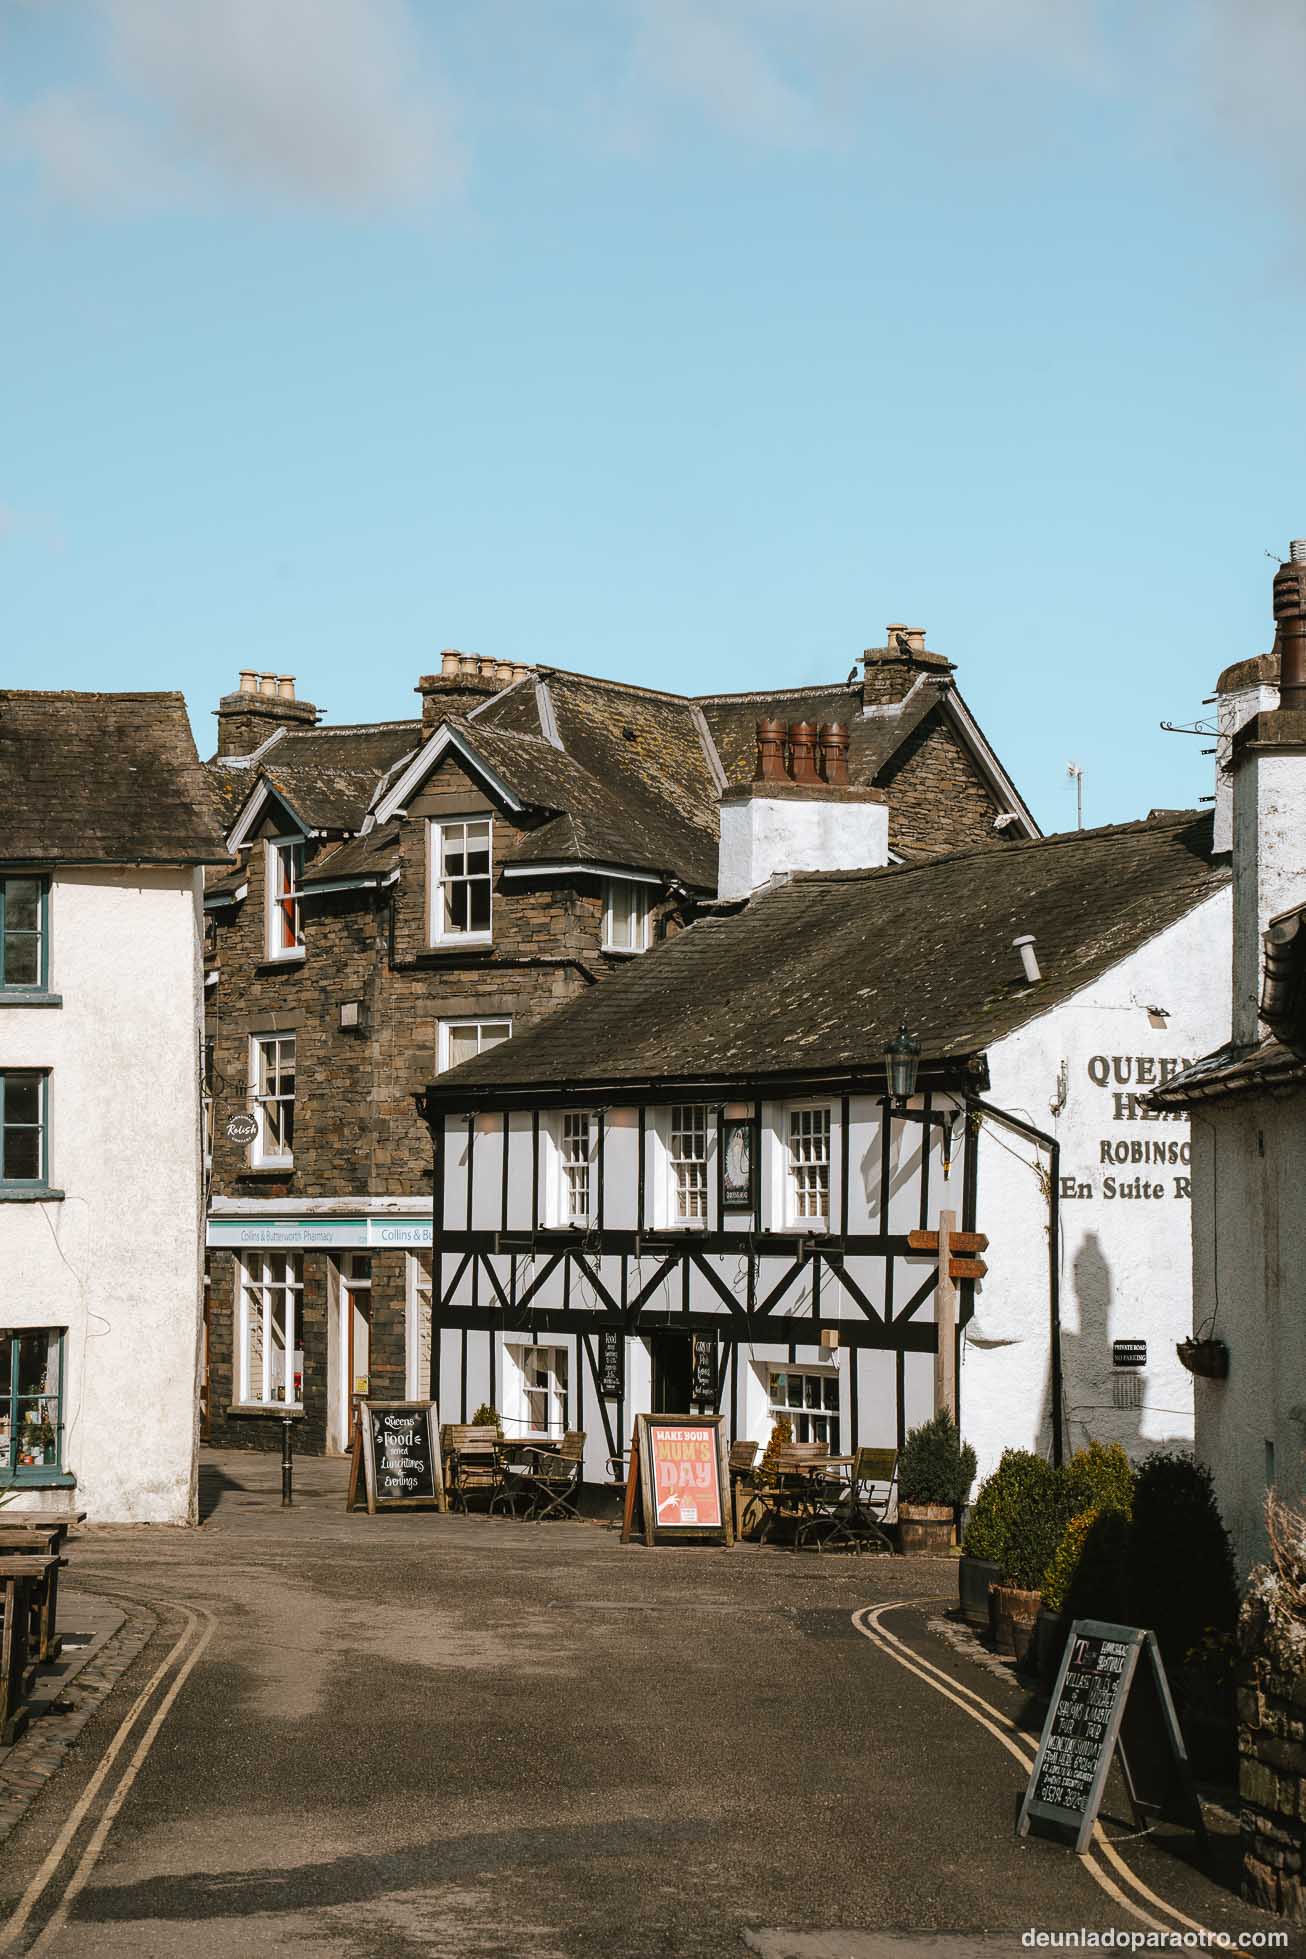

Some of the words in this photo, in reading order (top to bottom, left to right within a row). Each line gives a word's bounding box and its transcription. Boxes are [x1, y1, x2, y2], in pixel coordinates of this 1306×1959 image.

[1060, 1177, 1093, 1199] En
[1103, 1176, 1164, 1199] Suite
[382, 1229, 411, 1241] Collins
[414, 1229, 421, 1241] &
[384, 1415, 415, 1430] Queens
[384, 1430, 413, 1446] Food
[656, 1431, 682, 1440] MAKE
[684, 1431, 709, 1440] YOUR
[657, 1441, 711, 1461] MUM'S
[660, 1462, 712, 1488] DAY
[384, 1476, 418, 1491] Evenings
